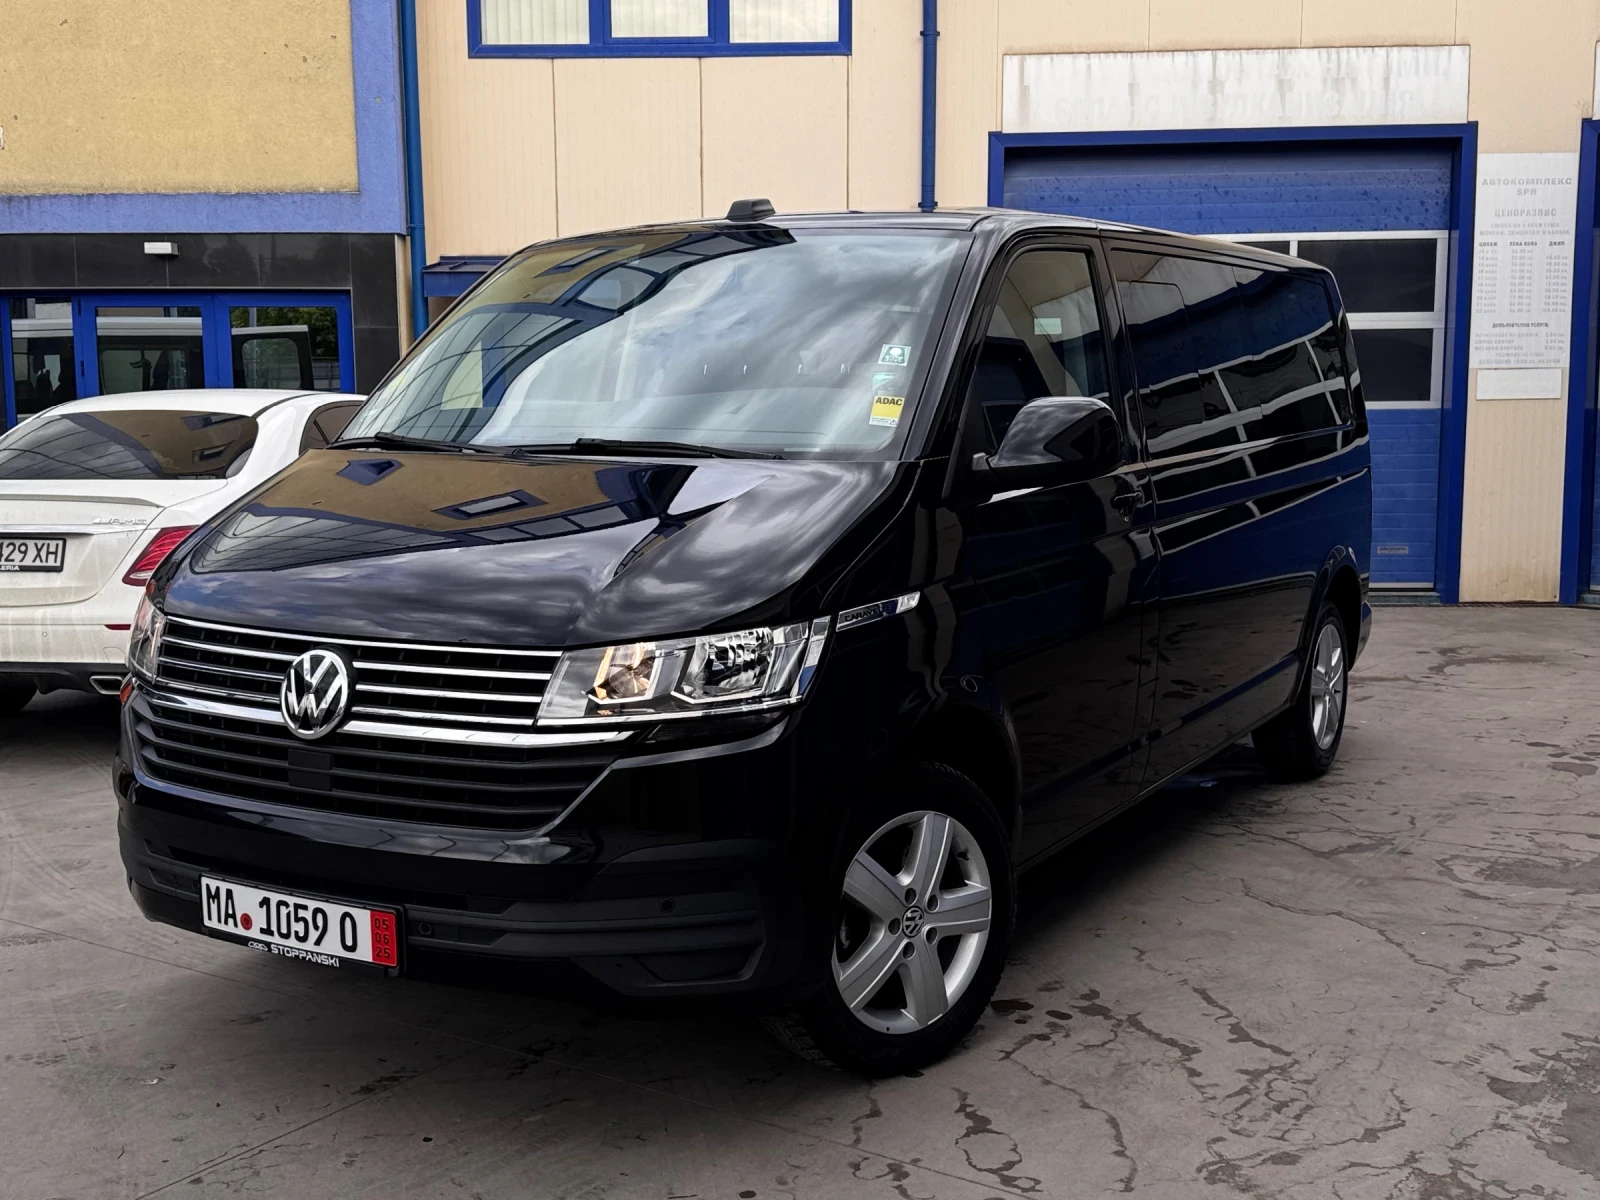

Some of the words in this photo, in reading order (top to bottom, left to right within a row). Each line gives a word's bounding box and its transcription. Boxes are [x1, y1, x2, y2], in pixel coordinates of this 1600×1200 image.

[1482, 177, 1572, 186] АВТОКОМПЛЕКС
[1516, 188, 1537, 196] SPR
[875, 397, 903, 406] ADAC
[205, 883, 238, 928] MA
[258, 896, 328, 947] 1059
[374, 917, 389, 930] 05
[375, 931, 390, 944] 06
[270, 944, 340, 967] STOPPANSKI
[375, 946, 390, 959] 25
